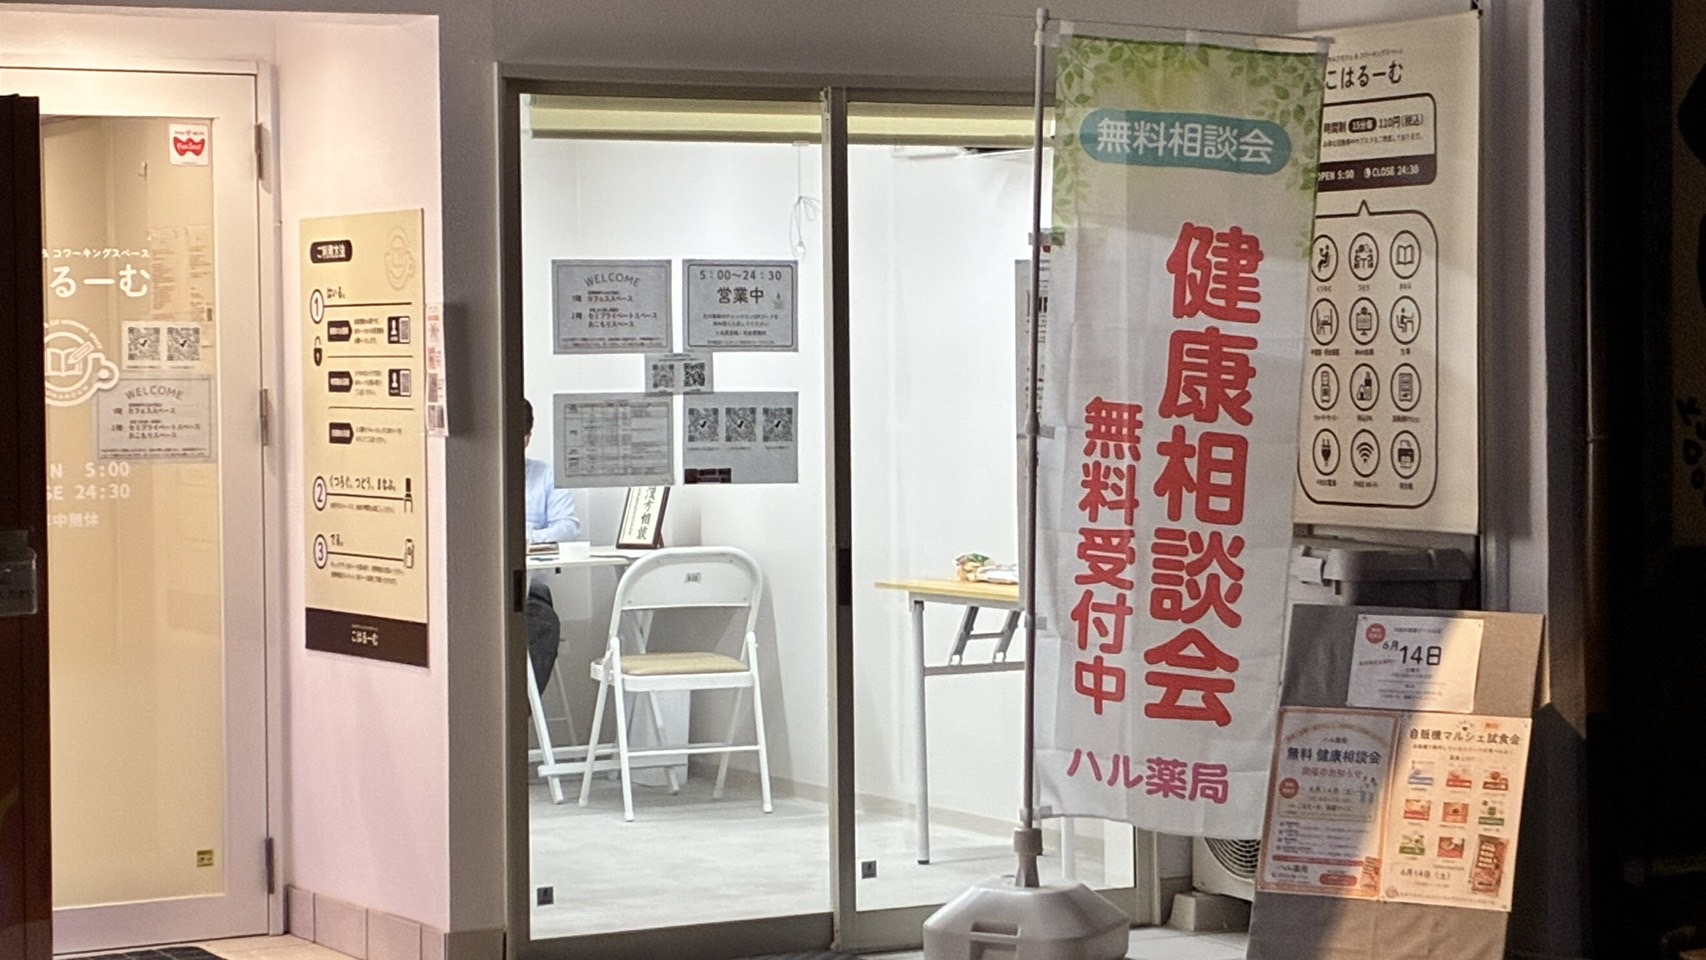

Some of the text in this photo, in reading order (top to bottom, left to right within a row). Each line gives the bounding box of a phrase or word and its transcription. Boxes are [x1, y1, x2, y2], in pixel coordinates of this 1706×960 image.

[1325, 60, 1403, 90] こはるーむ
[1096, 117, 1274, 165] 無料相談会
[1372, 166, 1395, 178] CLOSE
[53, 247, 151, 258] コワーキングスペース
[50, 264, 151, 298] るーむ
[584, 272, 641, 288] WELCOME
[717, 286, 764, 304] 営業中
[125, 384, 184, 400] WELCOME
[85, 461, 130, 478] 5:00
[1144, 221, 1264, 728] 健康相談会
[75, 483, 130, 500] 24:30
[317, 541, 323, 561] 3
[1070, 396, 1144, 716] 無料受付中
[1409, 728, 1521, 746] 自販機マルシェ試食会
[1286, 746, 1382, 764] 無料 健康相談会
[1067, 747, 1230, 804] ハル薬局
